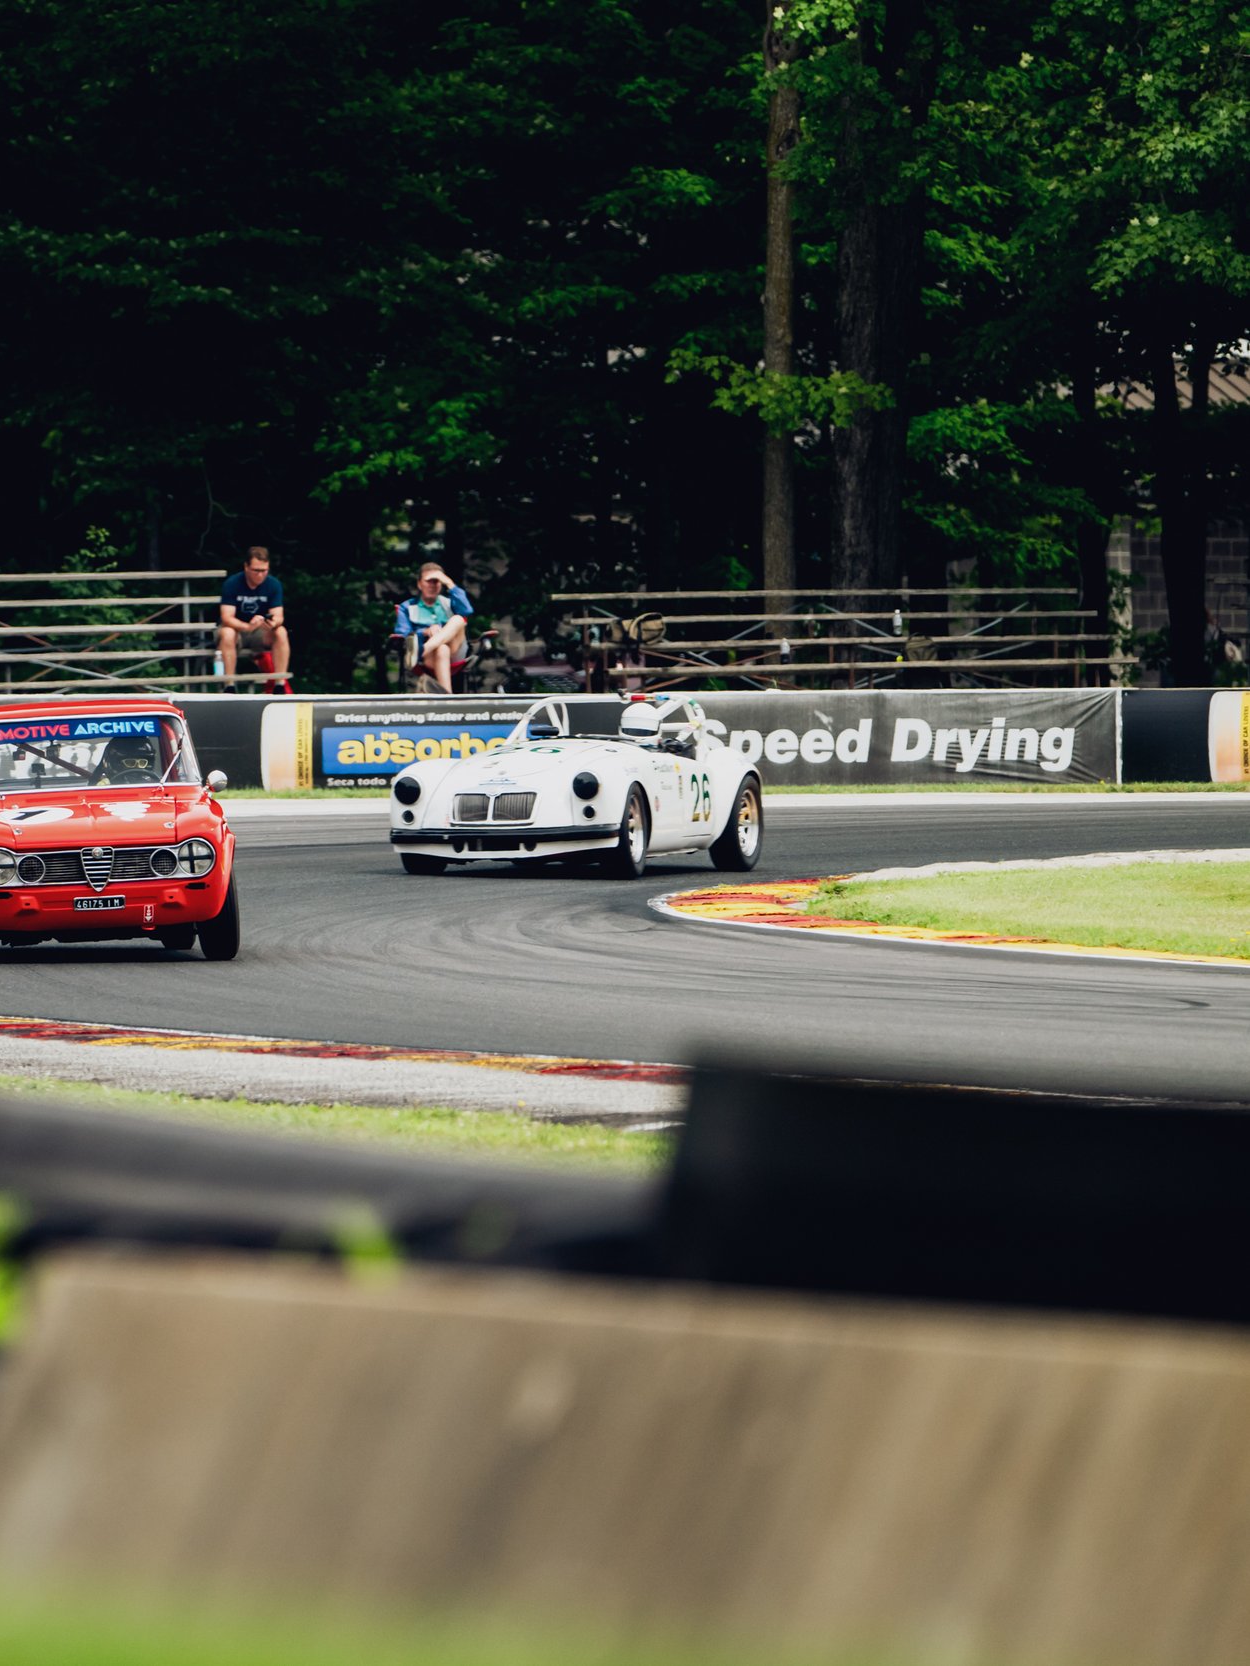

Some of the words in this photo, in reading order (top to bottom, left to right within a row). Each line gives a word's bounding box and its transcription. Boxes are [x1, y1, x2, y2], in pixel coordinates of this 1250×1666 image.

[368, 712, 426, 724] anything
[465, 711, 490, 721] and
[74, 720, 155, 736] ARCHIVE
[890, 716, 1077, 773] Drying
[327, 777, 355, 787] Seca
[357, 777, 387, 786] todo
[690, 773, 712, 823] 26
